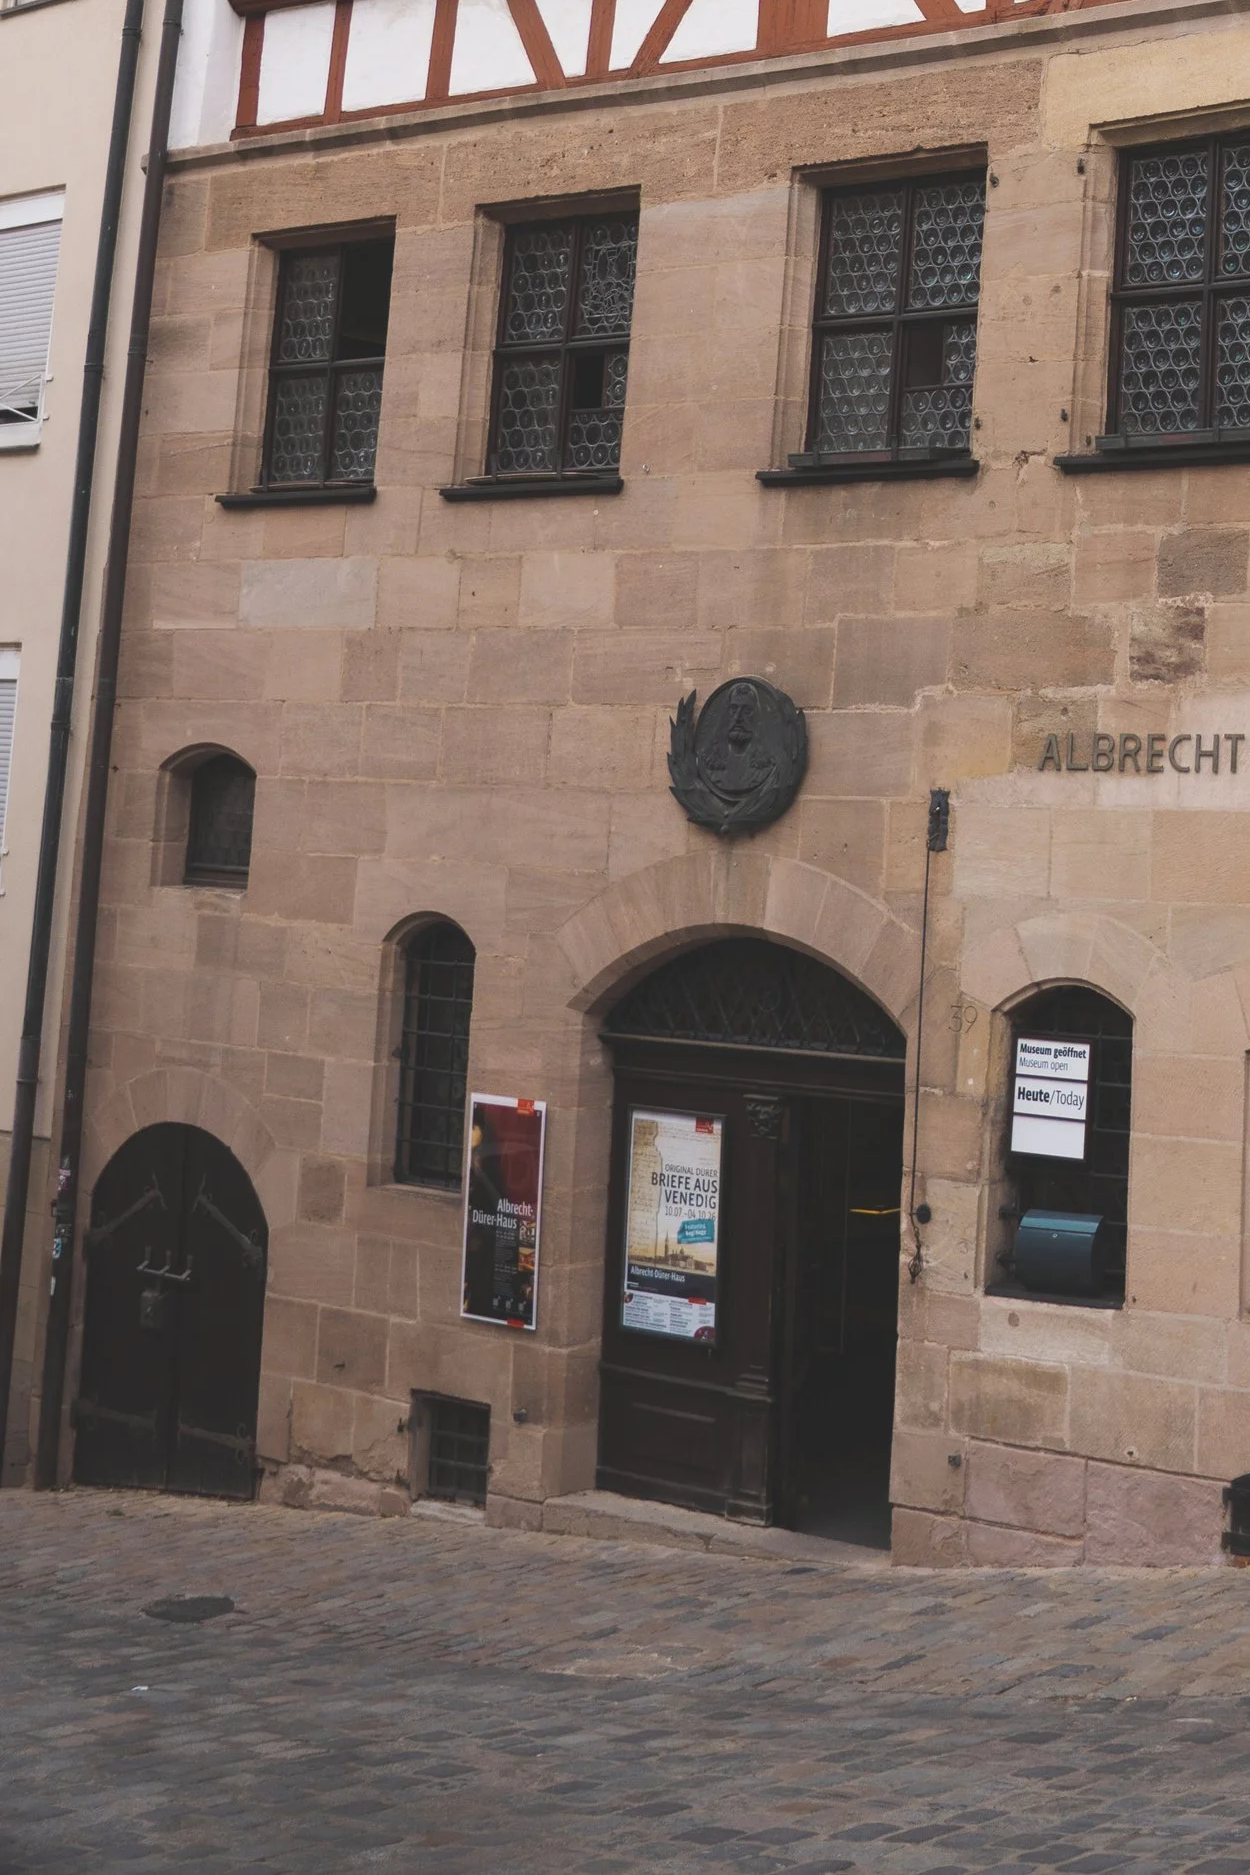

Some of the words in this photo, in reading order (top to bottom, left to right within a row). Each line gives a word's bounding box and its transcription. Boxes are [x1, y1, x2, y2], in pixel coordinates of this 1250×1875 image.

[948, 1005, 978, 1034] 39
[1020, 1043, 1052, 1056] Museum
[1053, 1046, 1087, 1059] geöffnet
[1019, 1057, 1049, 1069] Museum
[1050, 1061, 1069, 1072] open
[1017, 1086, 1085, 1111] Heute/Today
[665, 1163, 694, 1175] ORIGINAL
[651, 1171, 691, 1190] BRIEFE
[693, 1178, 718, 1194] AUS
[497, 1198, 534, 1217] Albrecht-
[664, 1189, 717, 1209] VENEDIG
[472, 1209, 518, 1230] Dürer-Haus
